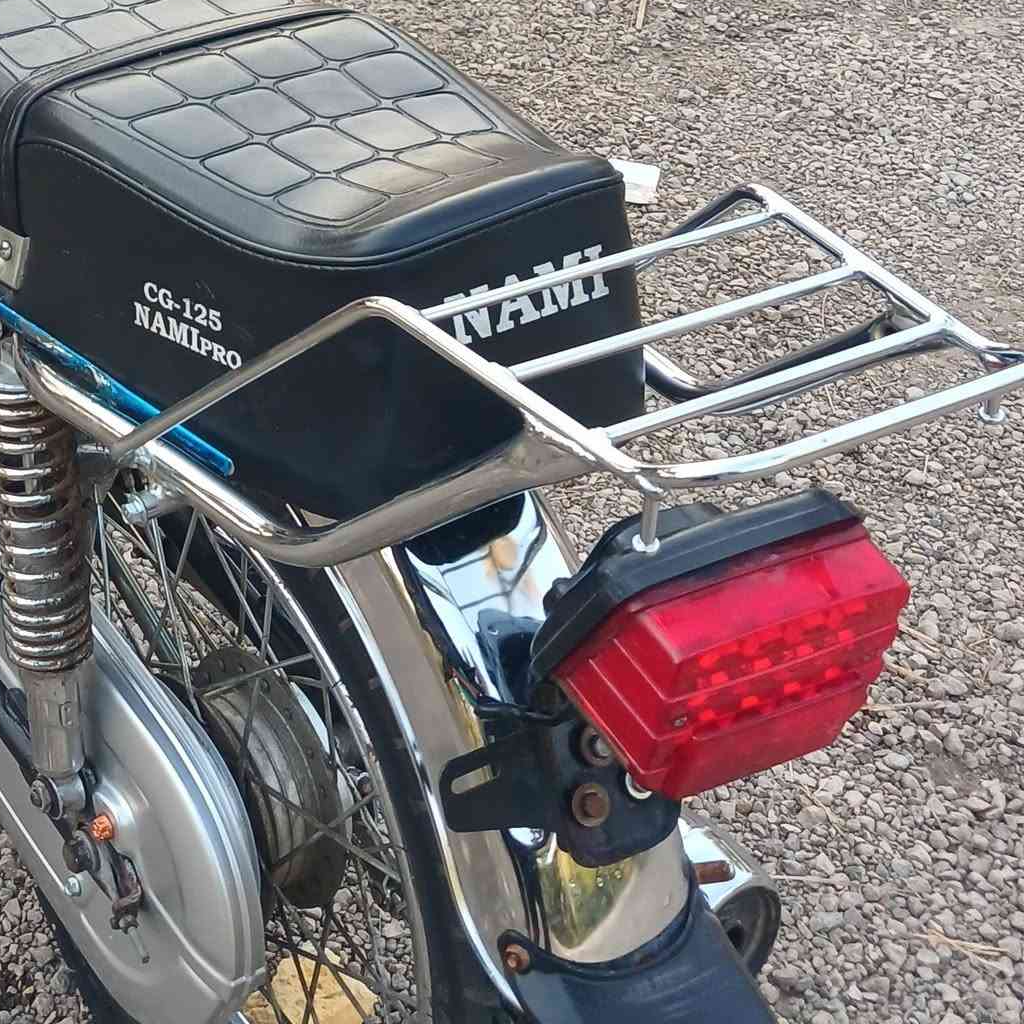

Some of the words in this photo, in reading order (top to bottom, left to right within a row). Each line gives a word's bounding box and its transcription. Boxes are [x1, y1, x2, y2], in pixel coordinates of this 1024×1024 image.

[143, 280, 223, 332] CG-125
[443, 243, 609, 344] NAMI
[133, 301, 241, 370] NAMIPRO
